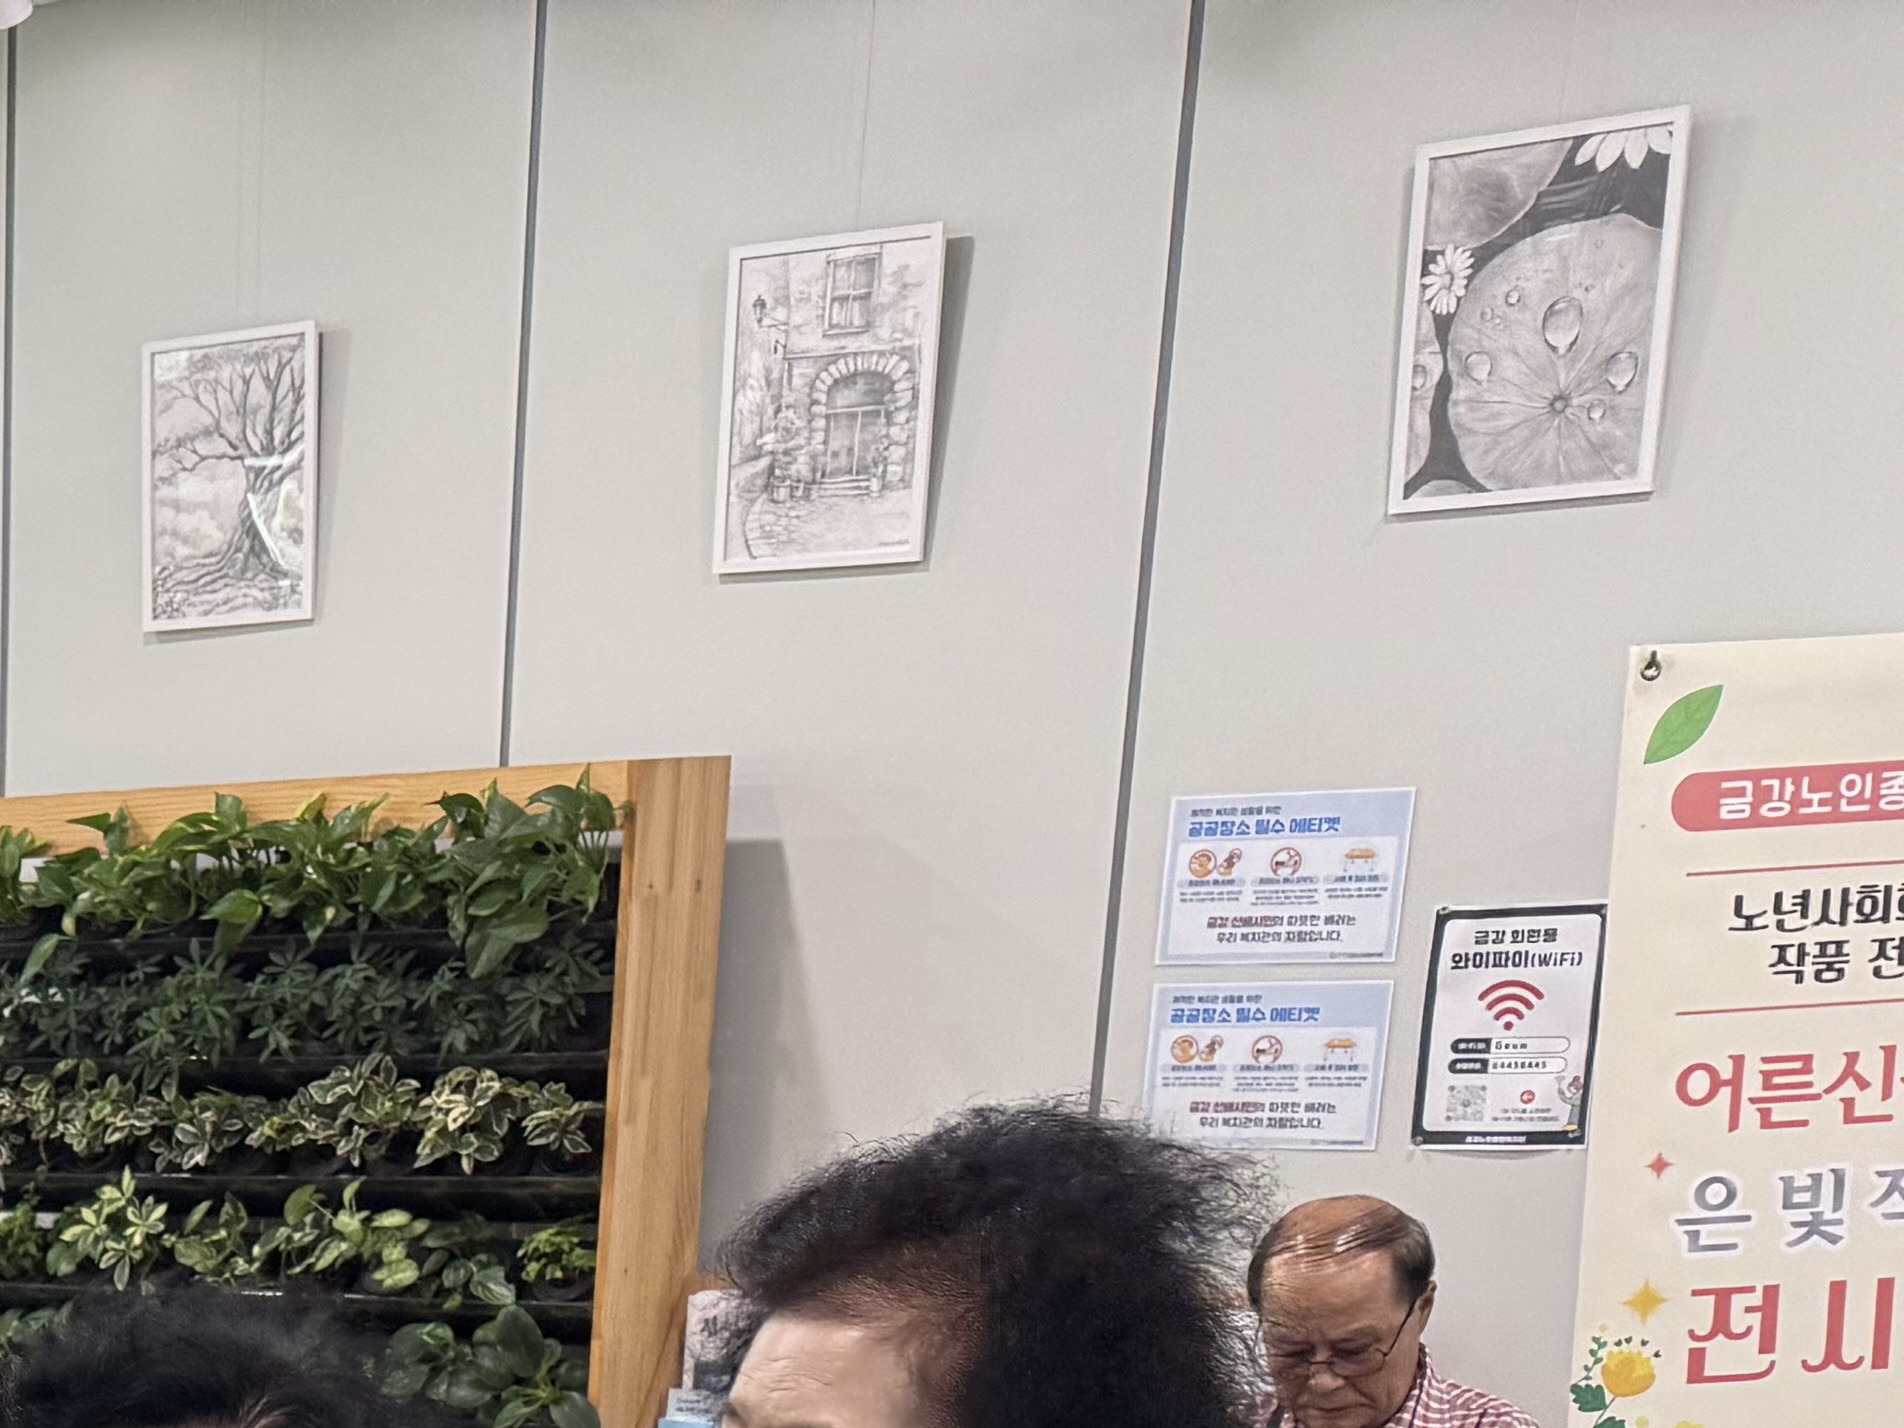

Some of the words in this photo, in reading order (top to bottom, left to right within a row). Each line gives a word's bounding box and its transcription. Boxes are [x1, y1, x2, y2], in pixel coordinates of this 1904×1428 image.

[1728, 883, 1904, 933] 노년사회
[1768, 939, 1850, 984] 작품
[1675, 1044, 1904, 1133] 어른신
